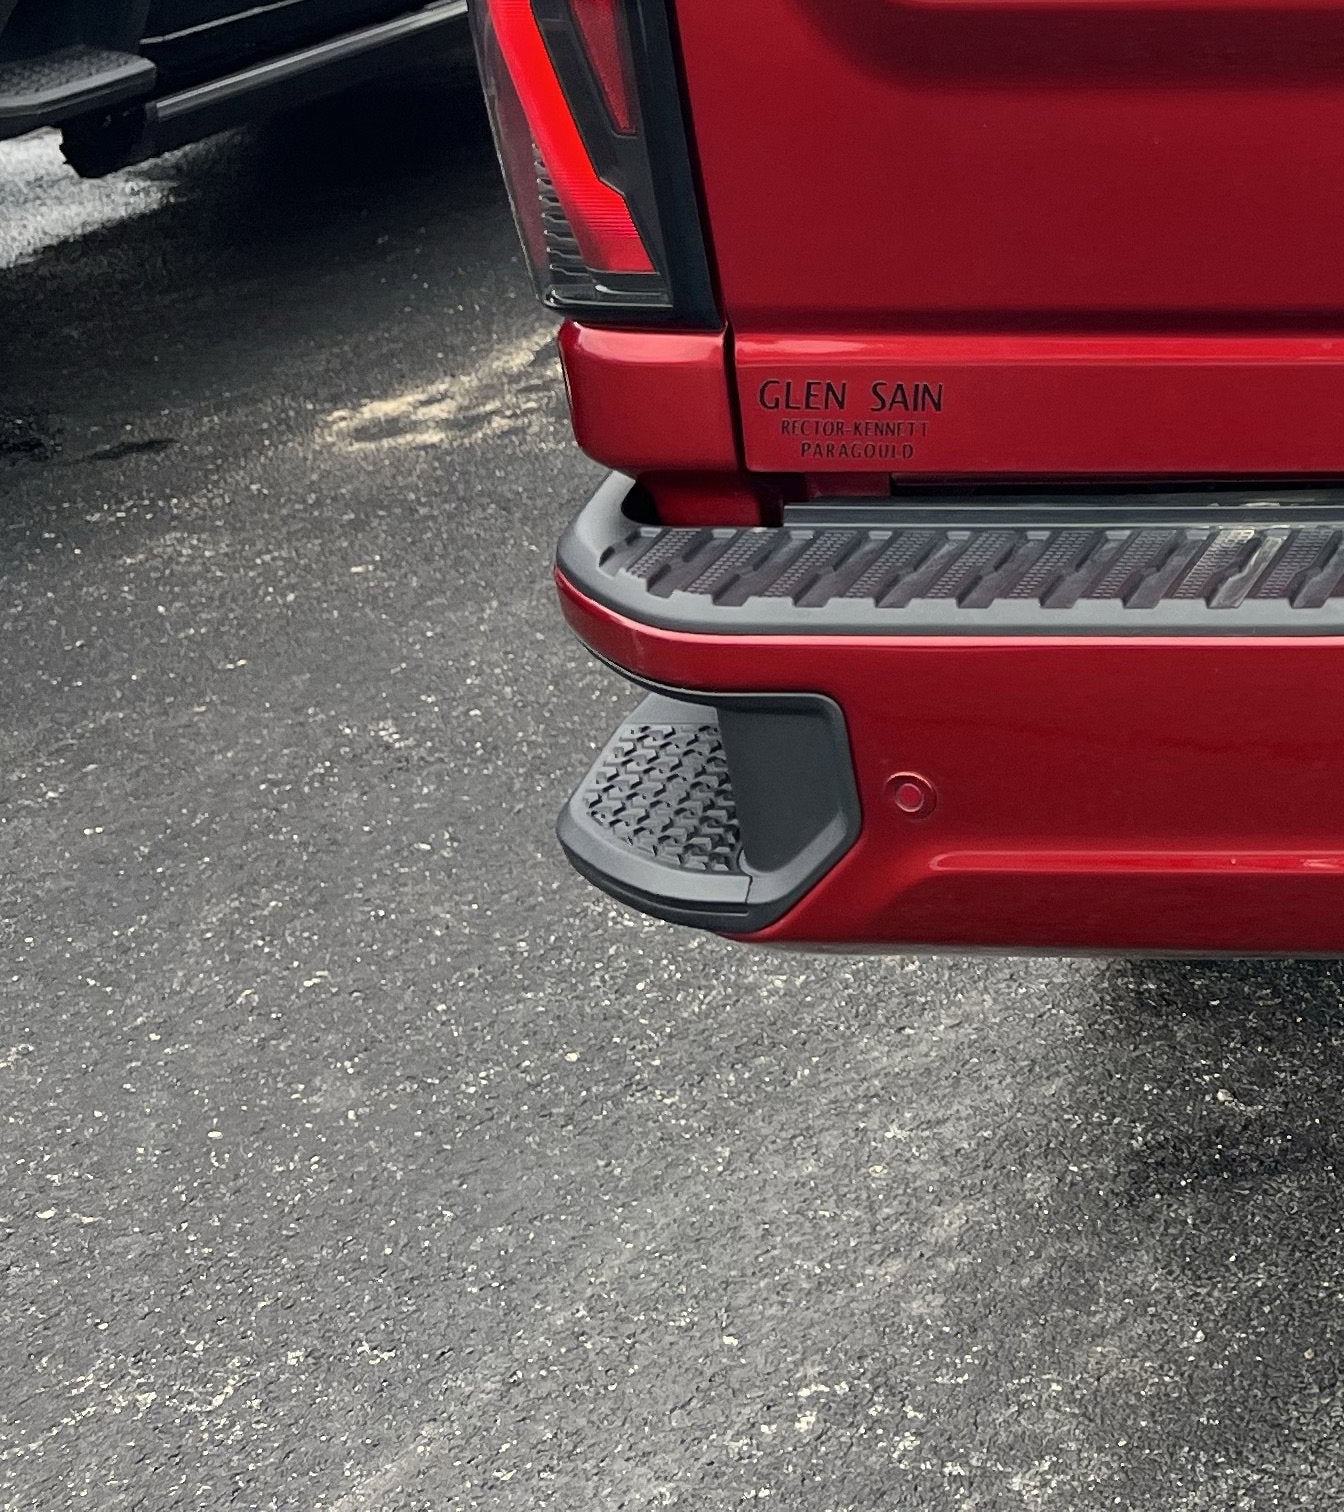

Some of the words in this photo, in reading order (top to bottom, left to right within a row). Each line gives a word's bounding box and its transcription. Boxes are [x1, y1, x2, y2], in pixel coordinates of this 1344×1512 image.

[758, 380, 847, 410] GLEN
[870, 382, 943, 412] SAIN
[801, 443, 914, 459] PARAGOULD
